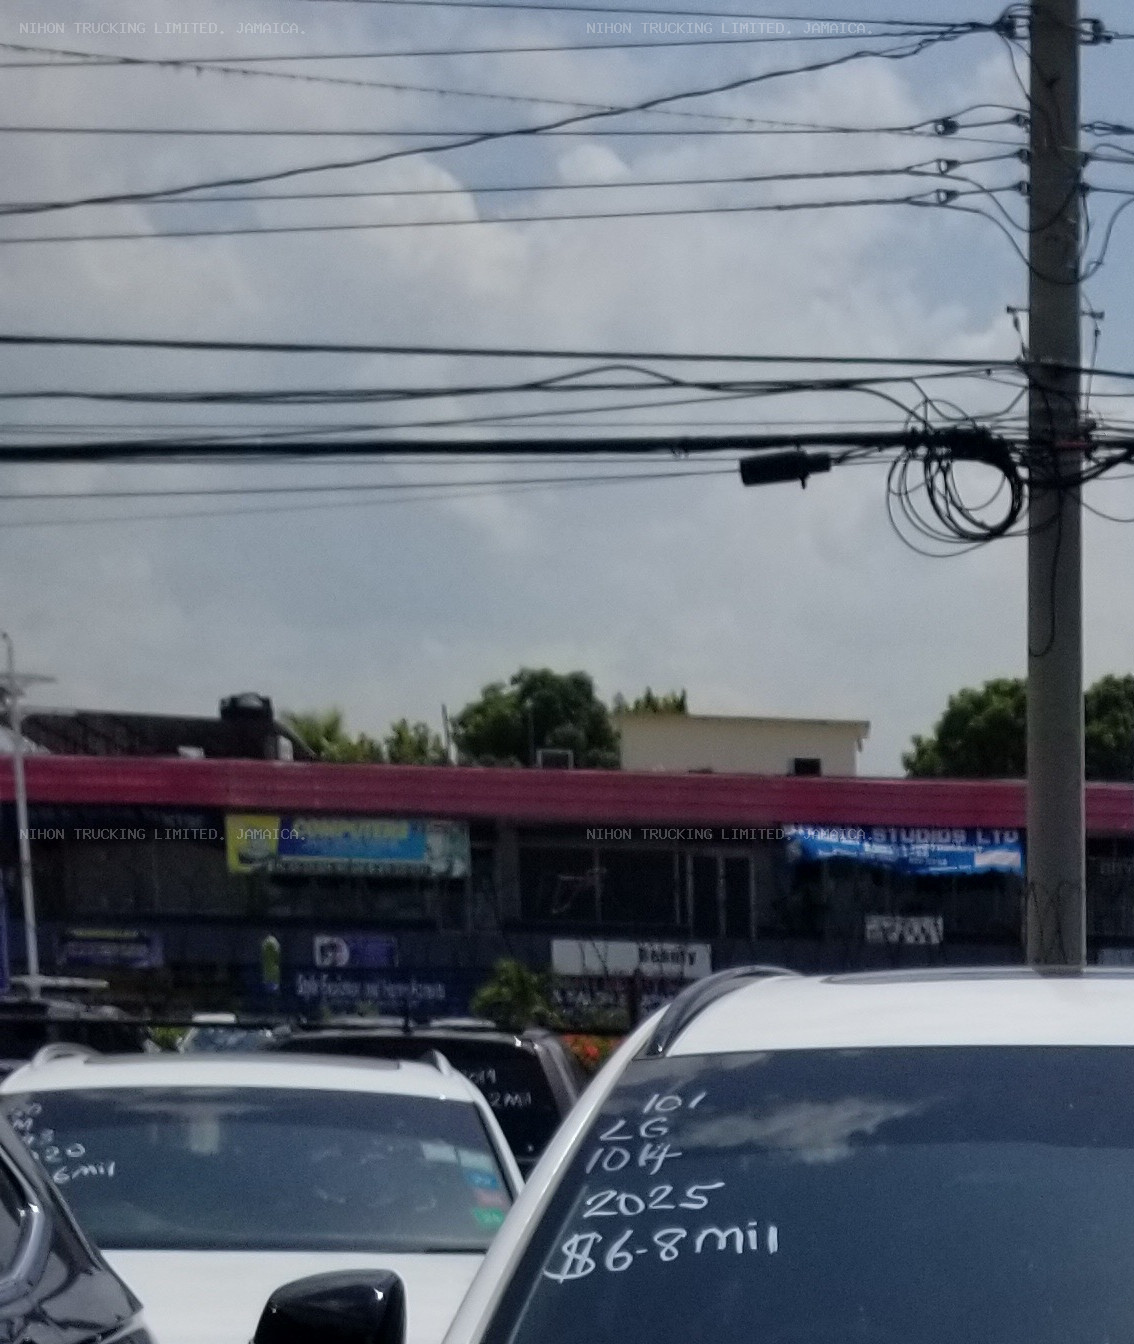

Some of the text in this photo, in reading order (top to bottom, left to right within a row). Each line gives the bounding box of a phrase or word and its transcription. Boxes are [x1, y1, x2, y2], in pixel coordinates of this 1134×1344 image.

[872, 827, 967, 845] STUDIOS
[976, 828, 1020, 844] LTD
[583, 1182, 725, 1218] 2025
